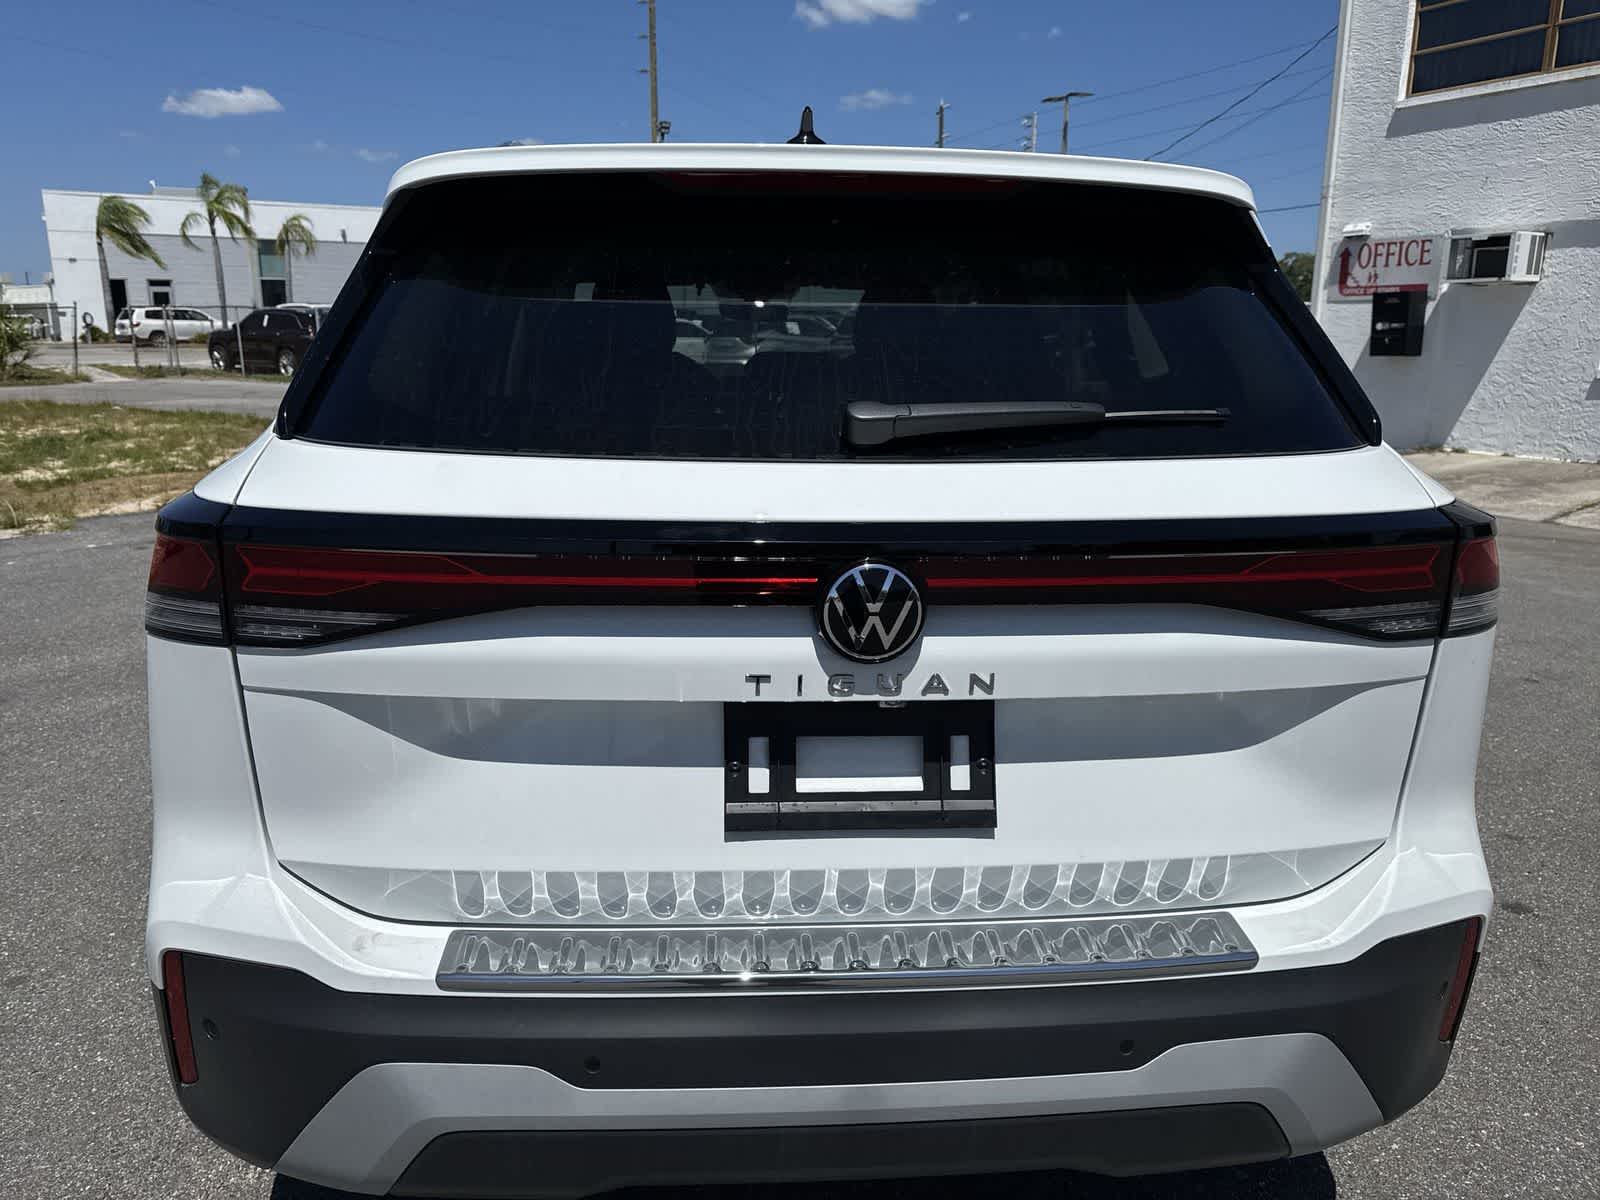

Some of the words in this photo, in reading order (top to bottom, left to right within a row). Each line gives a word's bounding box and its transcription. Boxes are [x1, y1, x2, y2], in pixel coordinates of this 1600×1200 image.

[1357, 239, 1433, 269] OFFICE
[825, 565, 922, 658] VW
[744, 672, 995, 697] TIGUAN
